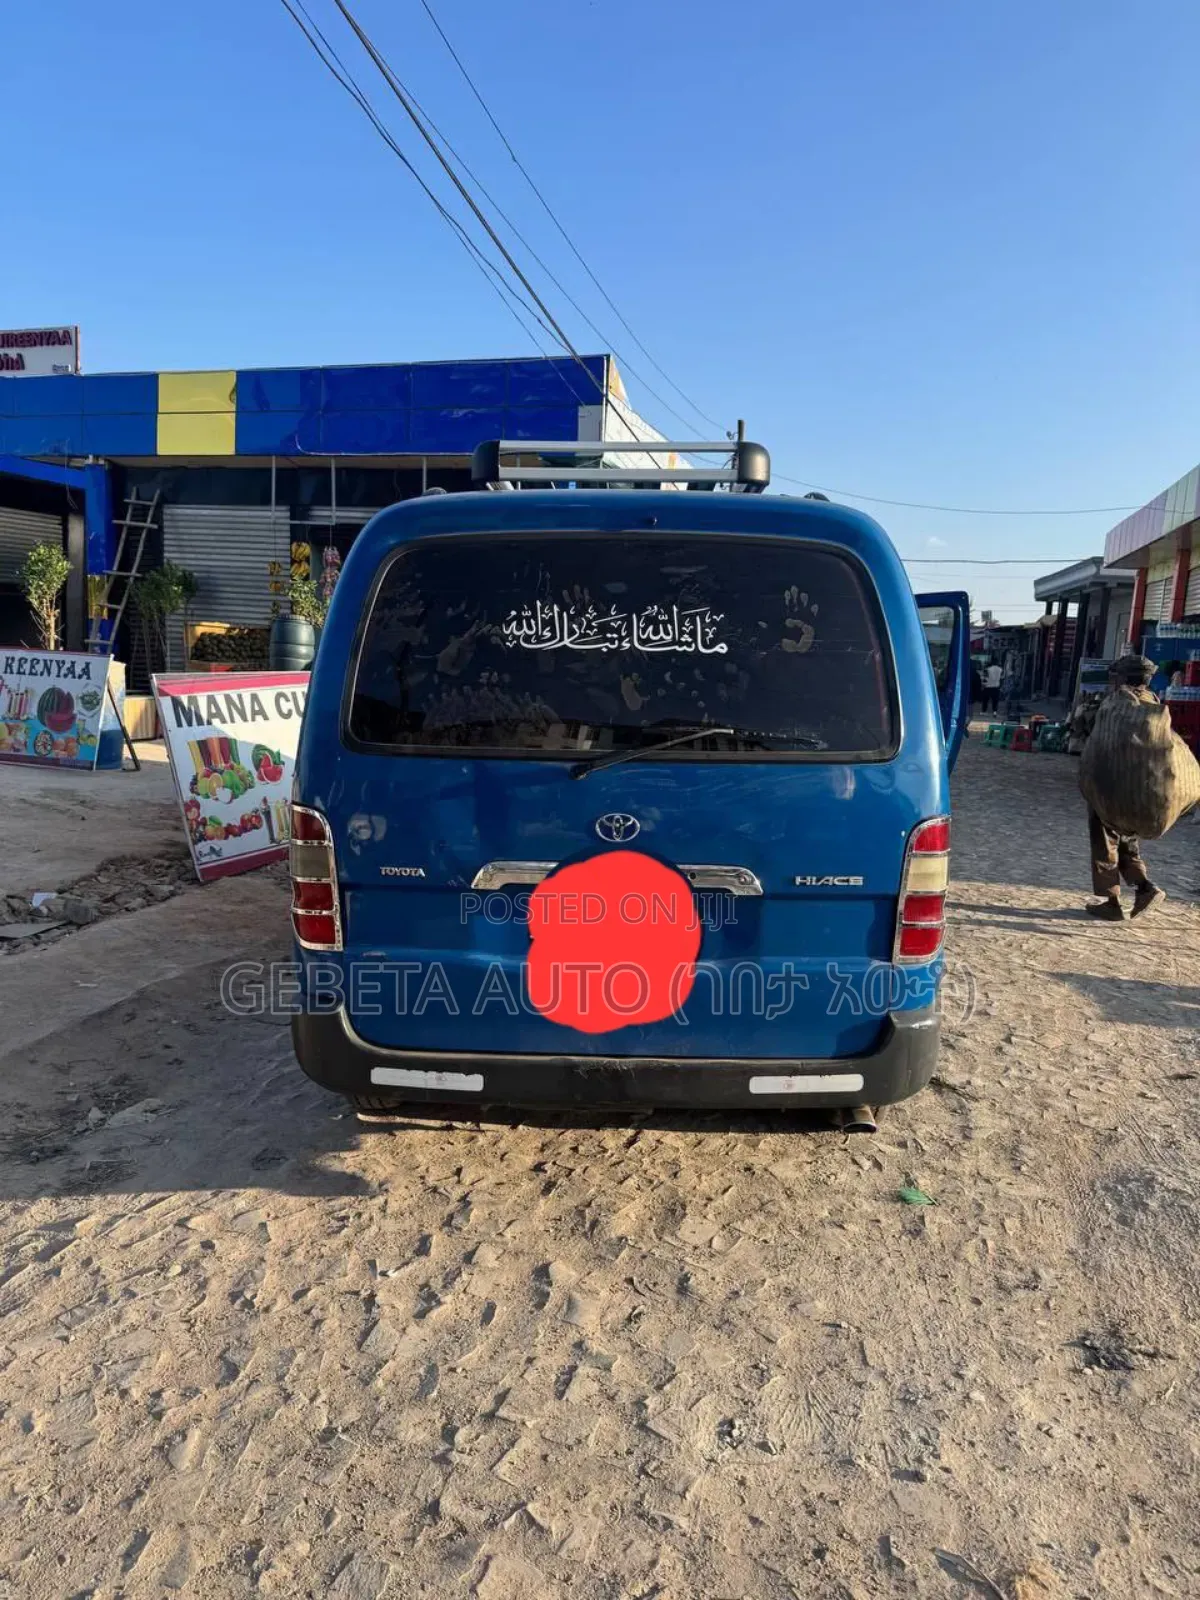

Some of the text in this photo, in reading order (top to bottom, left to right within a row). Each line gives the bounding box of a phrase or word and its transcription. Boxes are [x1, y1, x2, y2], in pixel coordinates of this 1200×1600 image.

[3, 656, 91, 680] KEENYAA
[171, 691, 269, 728] MANA
[380, 867, 426, 877] TOYOTA
[795, 876, 864, 886] HIACE
